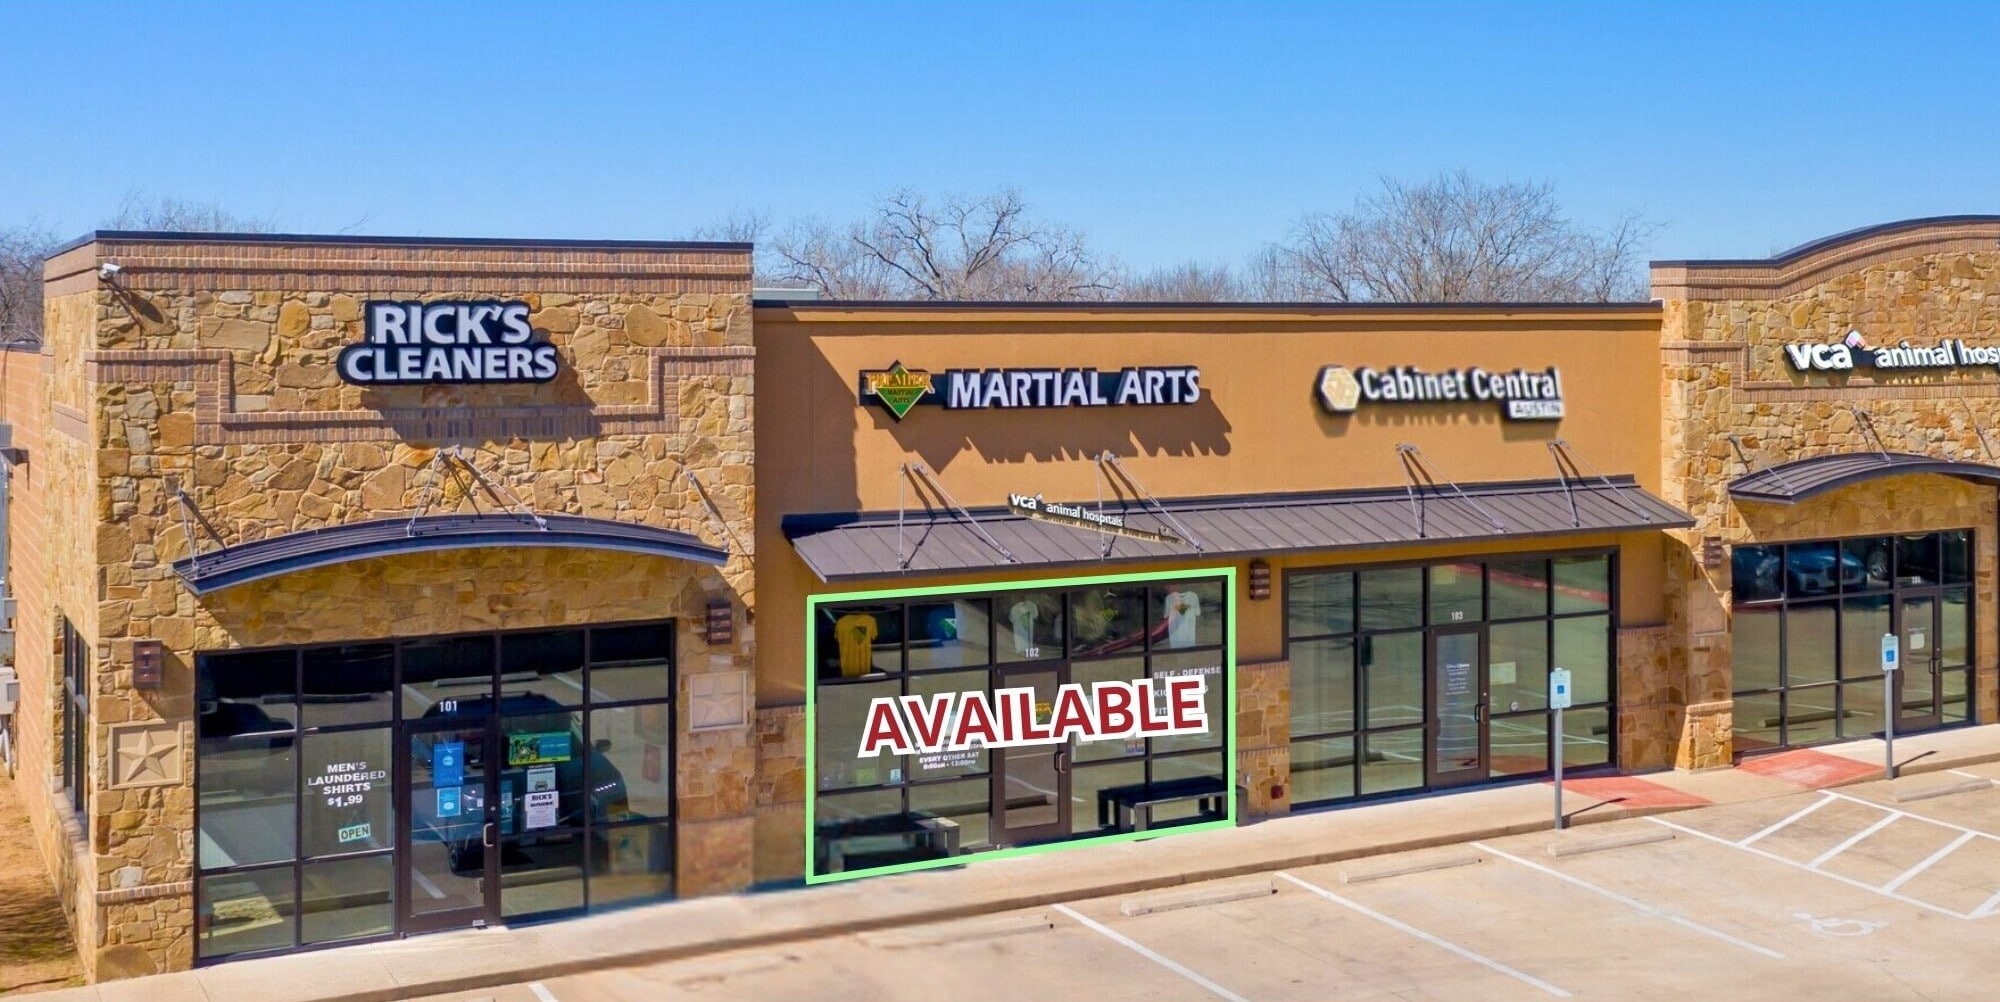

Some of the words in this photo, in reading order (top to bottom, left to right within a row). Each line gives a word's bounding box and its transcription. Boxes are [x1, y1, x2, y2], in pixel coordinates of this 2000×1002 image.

[374, 304, 531, 344] RICK'S
[1786, 343, 1854, 371] vca
[1875, 340, 1956, 368] animal
[1955, 338, 2000, 370] hos
[346, 346, 558, 381] CLEANERS
[950, 370, 1107, 408] MARTIAL
[1118, 368, 1201, 404] ARTS
[1360, 366, 1469, 400] Cabinet
[1472, 366, 1563, 400] Central
[1514, 401, 1561, 415] AUSTIN
[1010, 493, 1037, 510] vca
[1046, 503, 1081, 519] animal
[1082, 507, 1123, 528] hospitals
[1451, 611, 1464, 621] 103
[1025, 647, 1040, 658] 102
[1153, 669, 1176, 680] SELF
[439, 700, 458, 713] 101
[919, 754, 941, 764] EVERY
[943, 753, 965, 762] OTHER
[327, 761, 367, 774] MEN'S
[308, 770, 386, 786] LAUNDERED
[323, 782, 371, 795] SHIRTS
[327, 794, 363, 808] $1.99
[340, 825, 370, 841] OPEN
